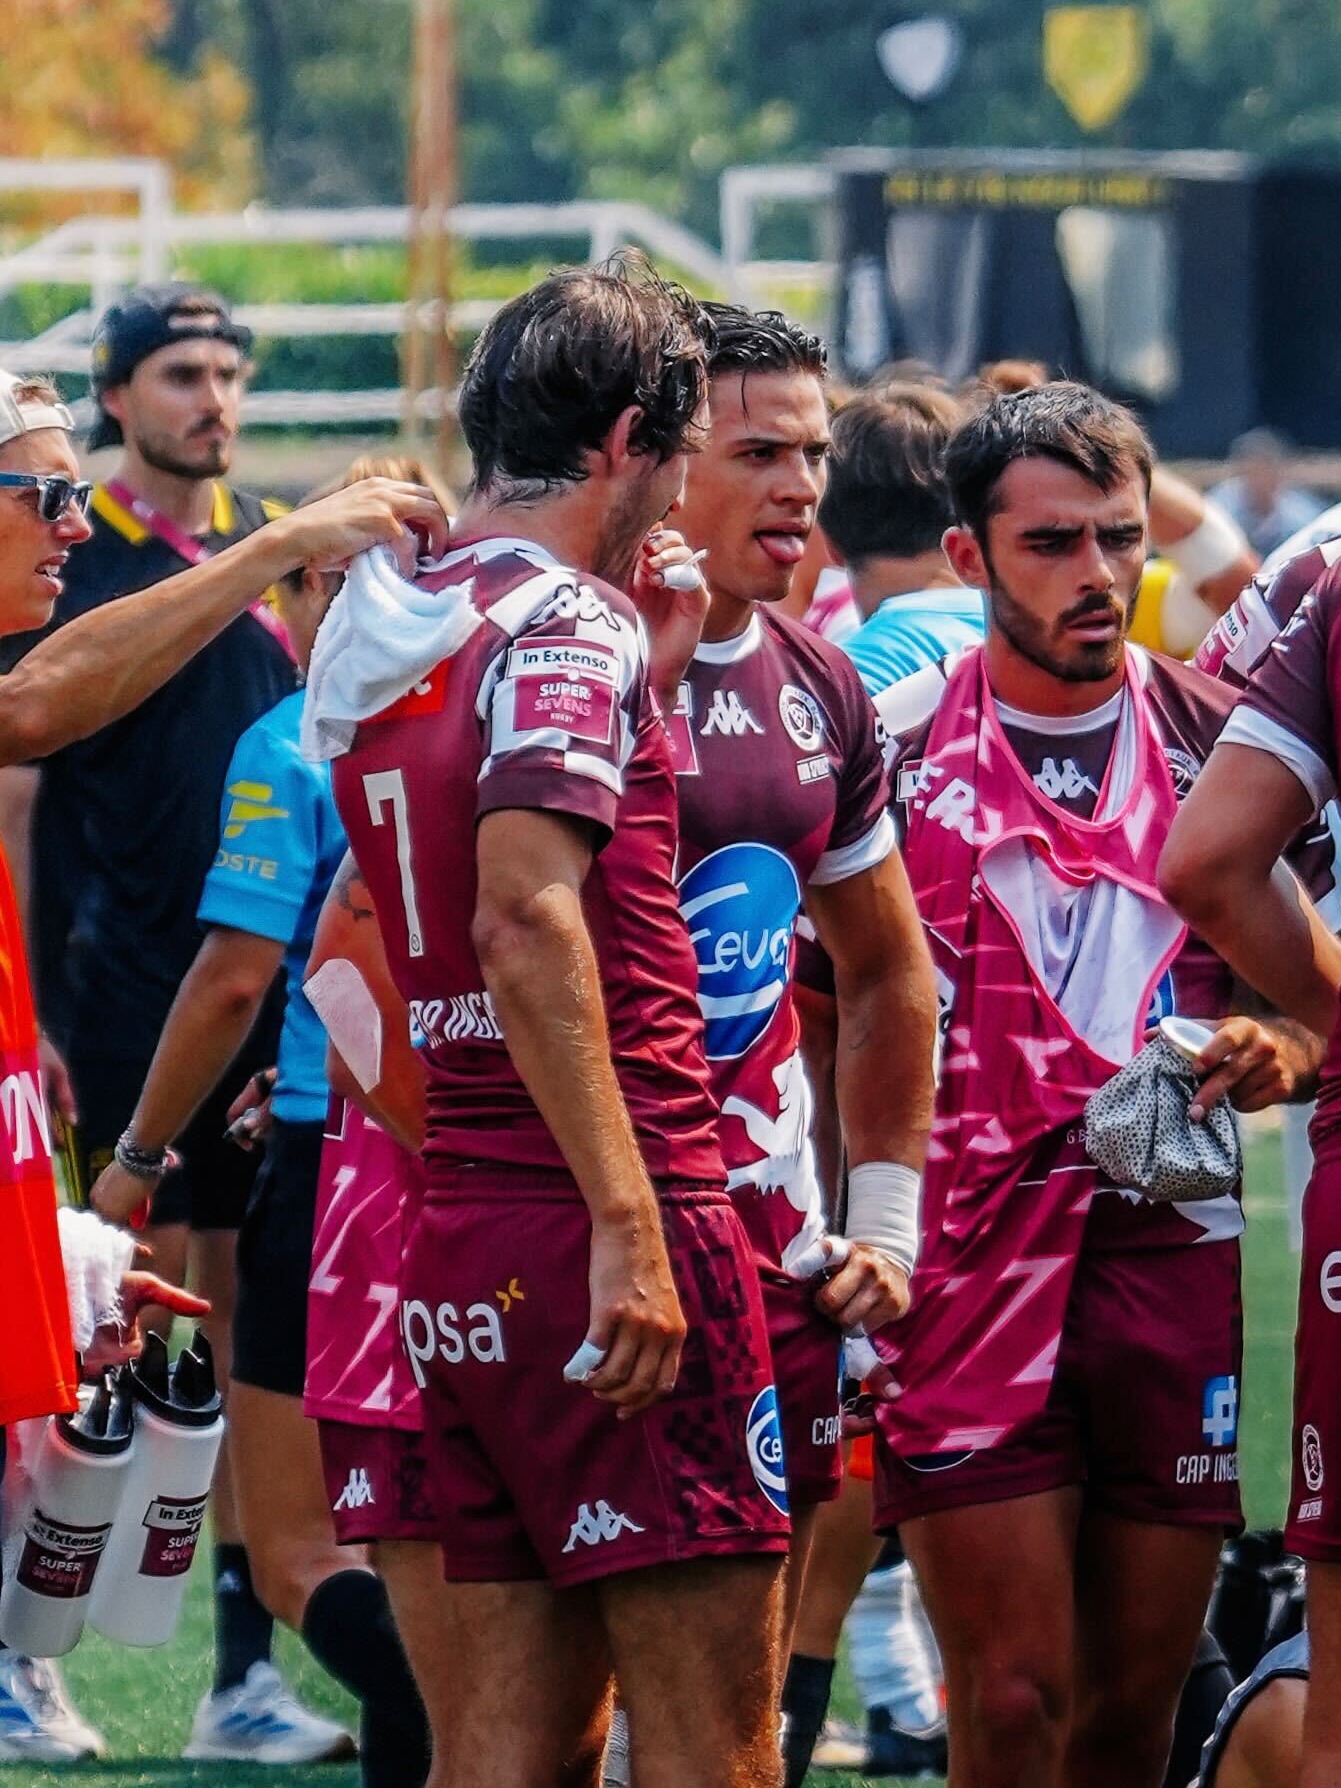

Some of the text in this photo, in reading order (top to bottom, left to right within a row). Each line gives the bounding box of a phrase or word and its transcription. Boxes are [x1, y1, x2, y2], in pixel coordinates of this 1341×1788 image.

[523, 650, 608, 670] In Extenso
[539, 682, 592, 699] SUPER
[534, 697, 592, 717] SEVENS
[362, 768, 426, 958] 7
[400, 1298, 506, 1389] psa
[1175, 1454, 1210, 1484] CAP
[40, 1555, 82, 1573] SUPER
